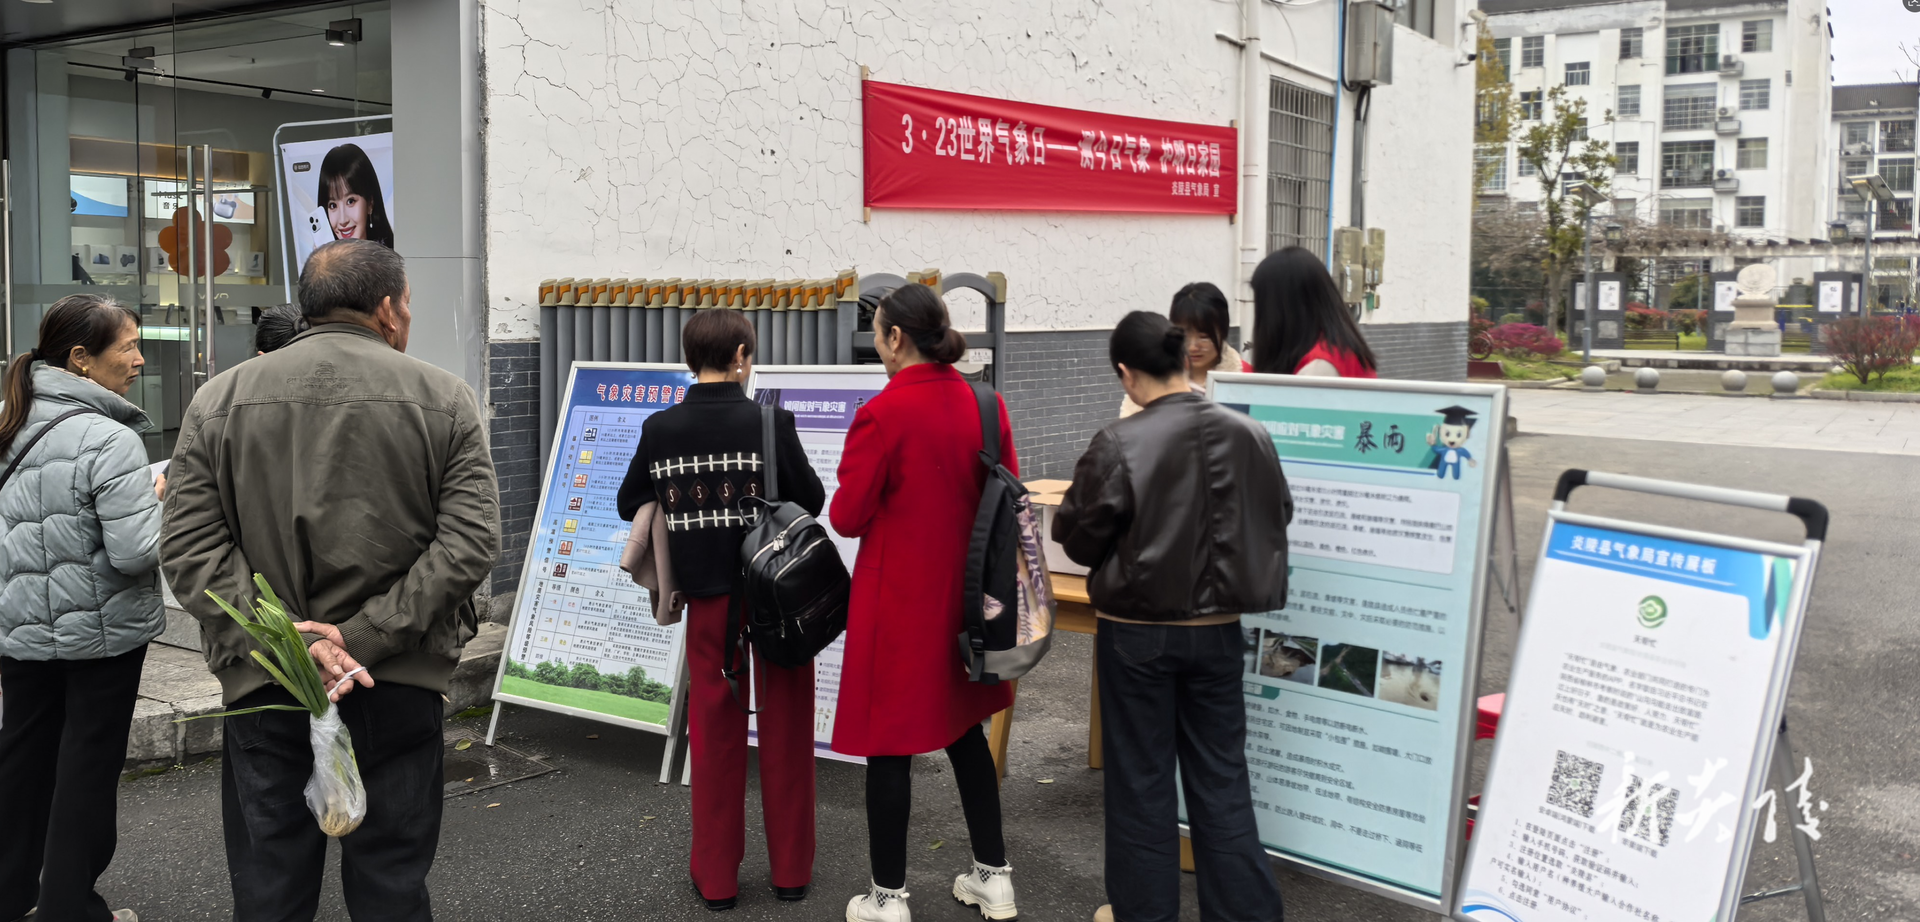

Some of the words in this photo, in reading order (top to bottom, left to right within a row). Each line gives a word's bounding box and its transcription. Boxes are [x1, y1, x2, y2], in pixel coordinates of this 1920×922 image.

[1171, 181, 1209, 197] 炎陵县气象局
[597, 383, 686, 404] 气象灾害预警信
[784, 400, 847, 413] 如何应对气象灾害
[1354, 421, 1405, 454] 暴雨
[1570, 534, 1718, 575] 炎陵县气象局宣传展板
[1633, 635, 1657, 648] 天帮忙
